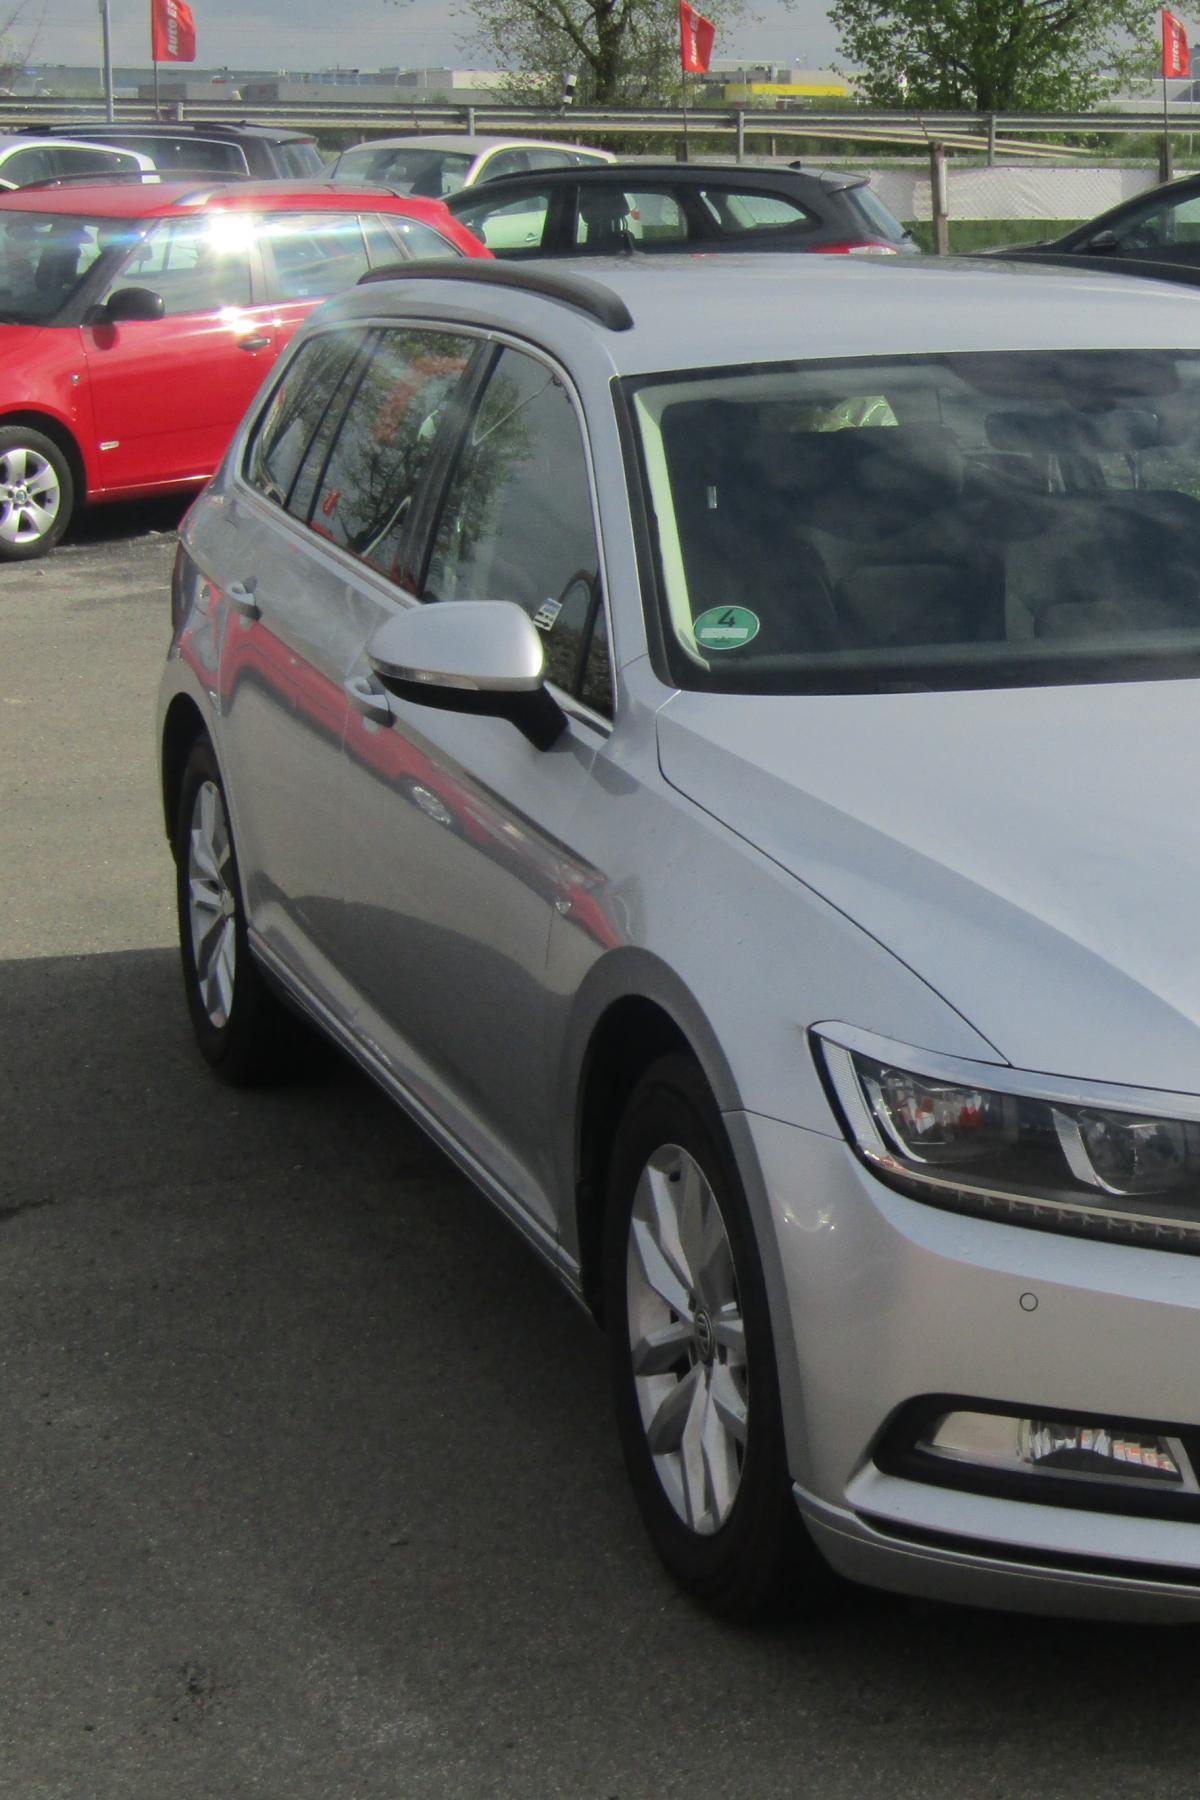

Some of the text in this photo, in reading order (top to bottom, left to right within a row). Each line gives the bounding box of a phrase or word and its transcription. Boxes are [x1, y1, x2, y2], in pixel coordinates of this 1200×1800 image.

[167, 19, 178, 56] Auto
[1172, 40, 1181, 71] Auto
[718, 609, 736, 628] 4
